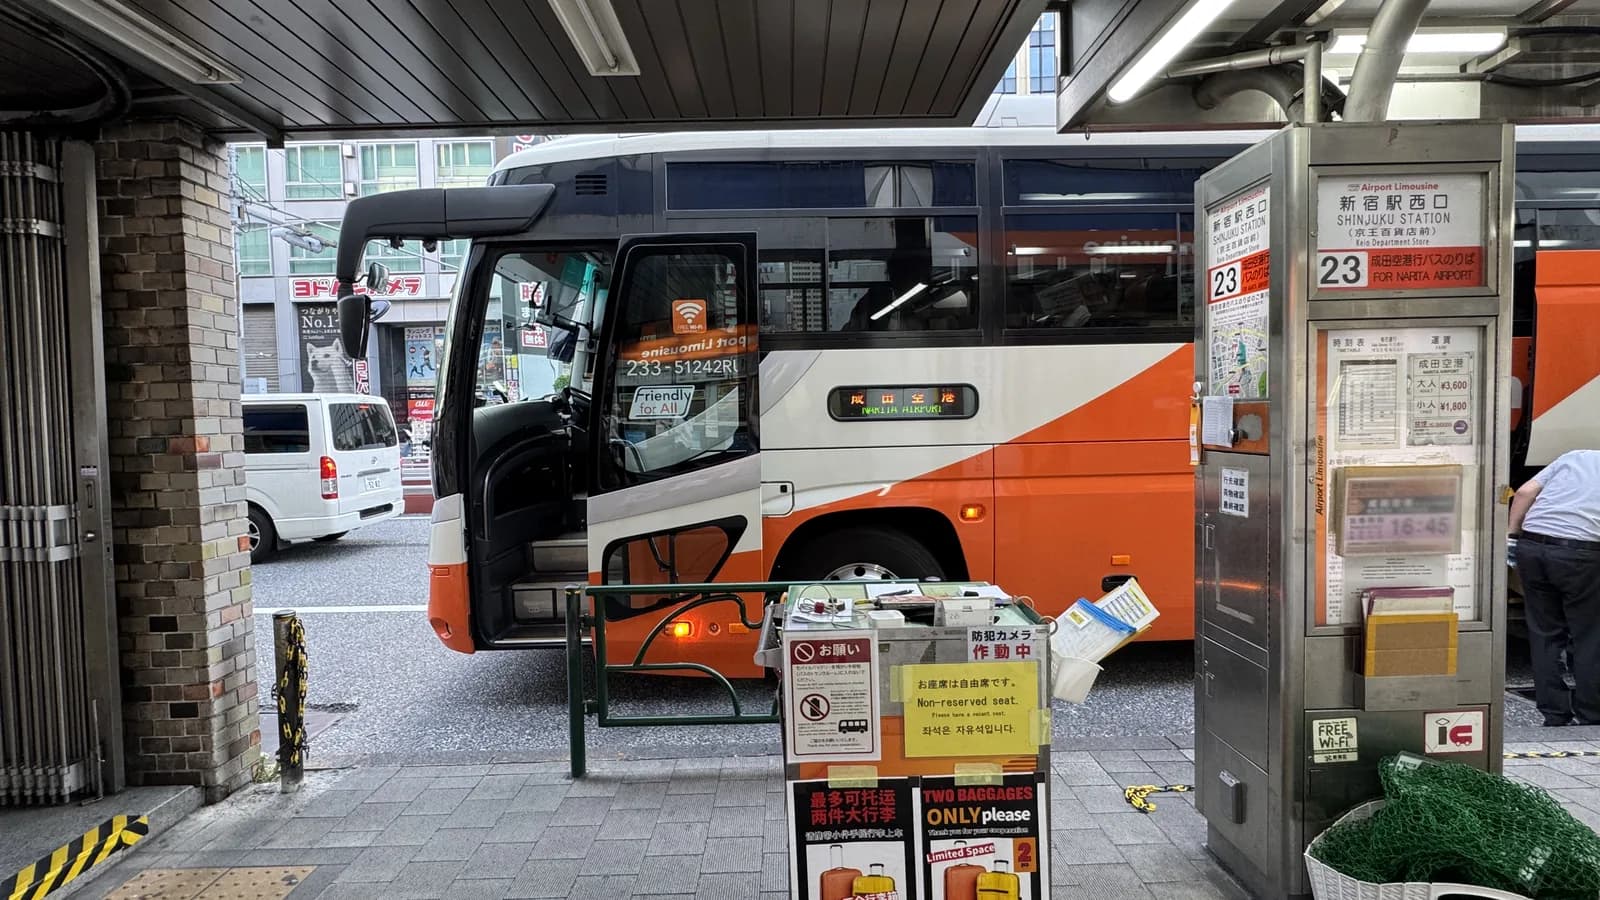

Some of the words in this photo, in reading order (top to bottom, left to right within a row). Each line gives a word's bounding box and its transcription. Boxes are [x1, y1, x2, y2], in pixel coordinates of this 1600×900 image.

[1361, 182, 1392, 193] Airport
[1393, 181, 1439, 191] Limousine
[1339, 194, 1449, 212] 新宿駅西口
[1240, 215, 1266, 235] STATION
[1337, 213, 1395, 226] SHINJUKU
[1400, 212, 1451, 225] STATION
[1371, 238, 1410, 247] Department
[1412, 238, 1430, 246] Store
[1371, 252, 1476, 267] 成田空港行バスのりば
[1320, 255, 1362, 284] 23
[1373, 271, 1393, 282] FOR
[1396, 270, 1430, 281] NARITA
[1433, 270, 1474, 280] AIRPORT
[1214, 267, 1237, 296] 23
[1418, 358, 1464, 369] 成田空港
[1416, 379, 1437, 389] 大人
[1440, 380, 1468, 391] ¥3,600
[634, 388, 692, 403] Friendly
[640, 402, 656, 414] for
[660, 402, 679, 414] All
[1416, 400, 1437, 410] 小人
[1440, 401, 1467, 412] ¥1,800
[1316, 434, 1324, 482] Limousine
[1315, 482, 1324, 516] Airport
[1391, 518, 1449, 536] 16:45
[971, 630, 1032, 642] 防犯カメラ
[819, 643, 860, 657] お願い
[972, 643, 1032, 660] 作動中
[918, 678, 1016, 689] お座席は自由席です。
[917, 696, 987, 708] Non-reserved
[992, 696, 1018, 705] seat.
[922, 726, 951, 736] 좌석은
[1318, 724, 1349, 737] FREE
[1319, 736, 1349, 748] Wi-Fi
[810, 789, 896, 808] 最多可托运
[923, 788, 955, 803] TWO
[957, 786, 1033, 803] BAGGAGES
[811, 806, 897, 826] 两件大行李
[927, 806, 982, 826] ONLY
[982, 806, 1032, 825] please
[926, 848, 964, 863] Limited
[966, 843, 996, 857] Space
[1018, 842, 1032, 862] 2
